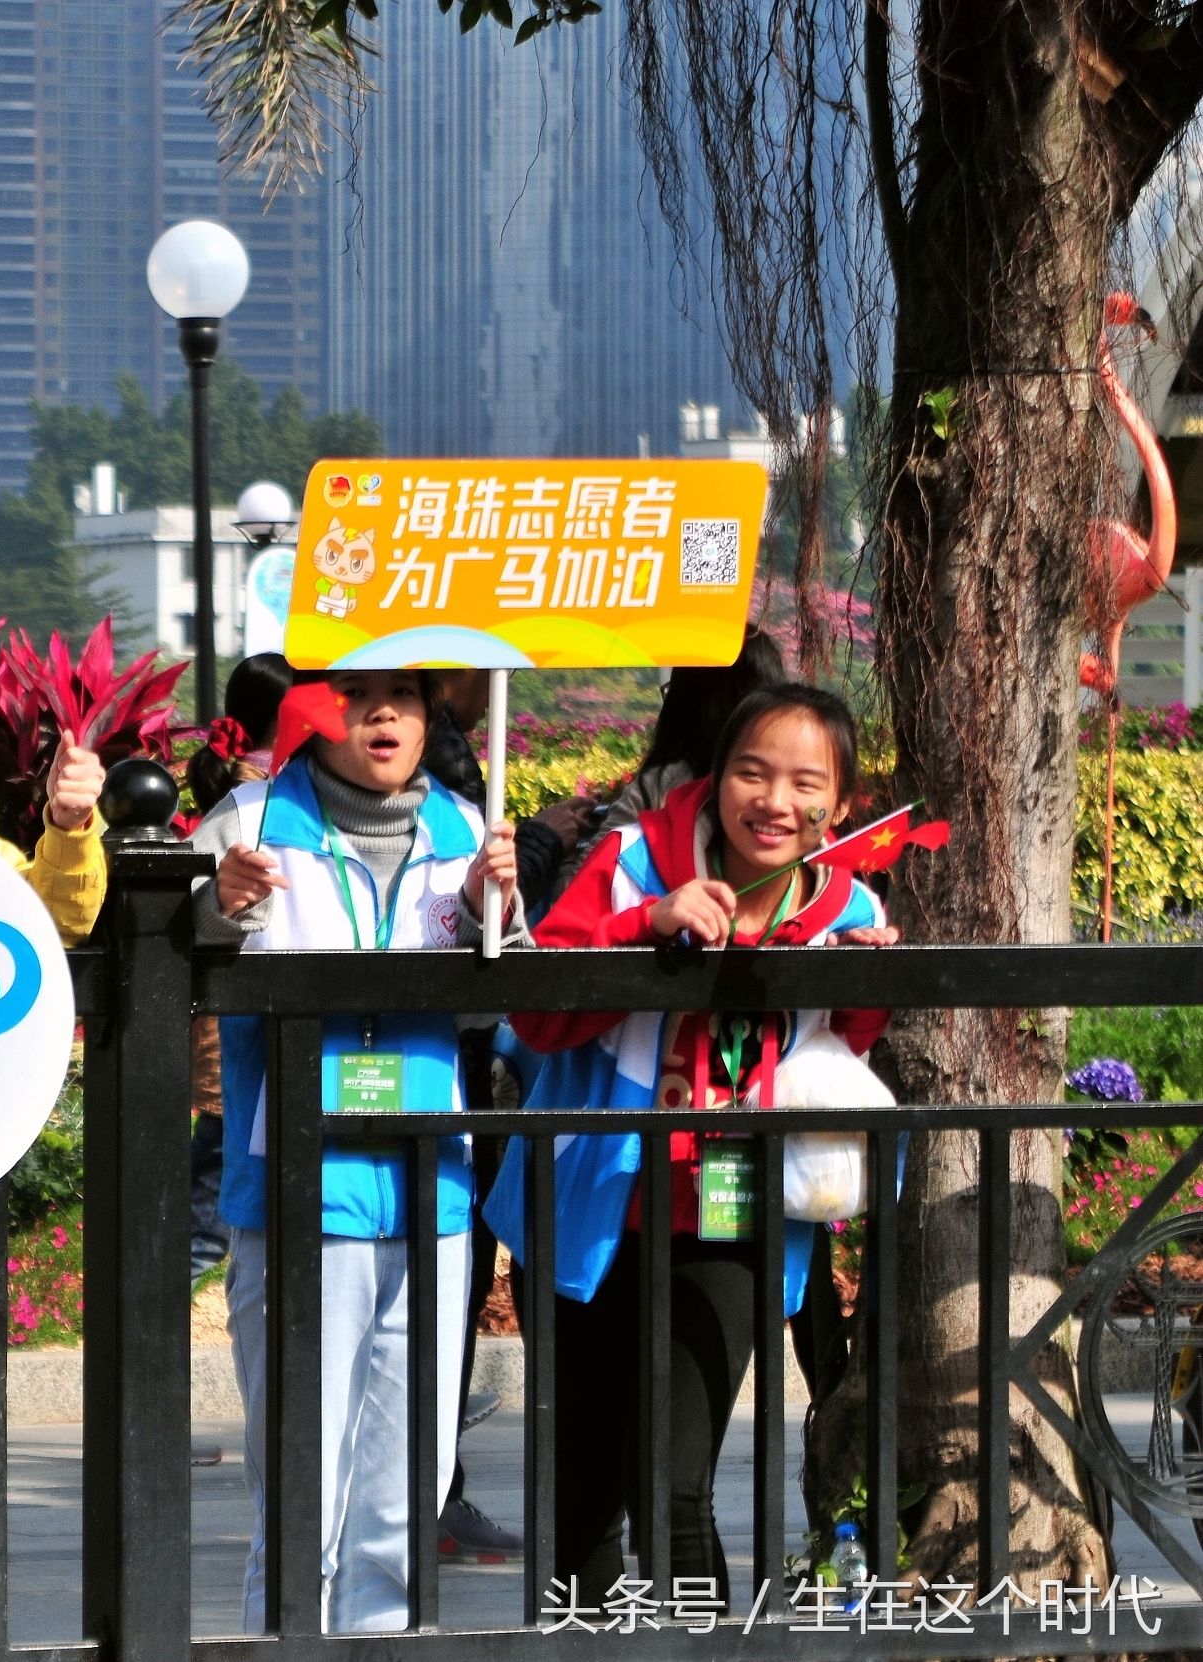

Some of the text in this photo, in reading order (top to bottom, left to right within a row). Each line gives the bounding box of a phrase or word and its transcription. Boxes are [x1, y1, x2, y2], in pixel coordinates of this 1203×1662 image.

[392, 476, 677, 540] 海珠志愿者
[379, 546, 666, 609] 为广马加油
